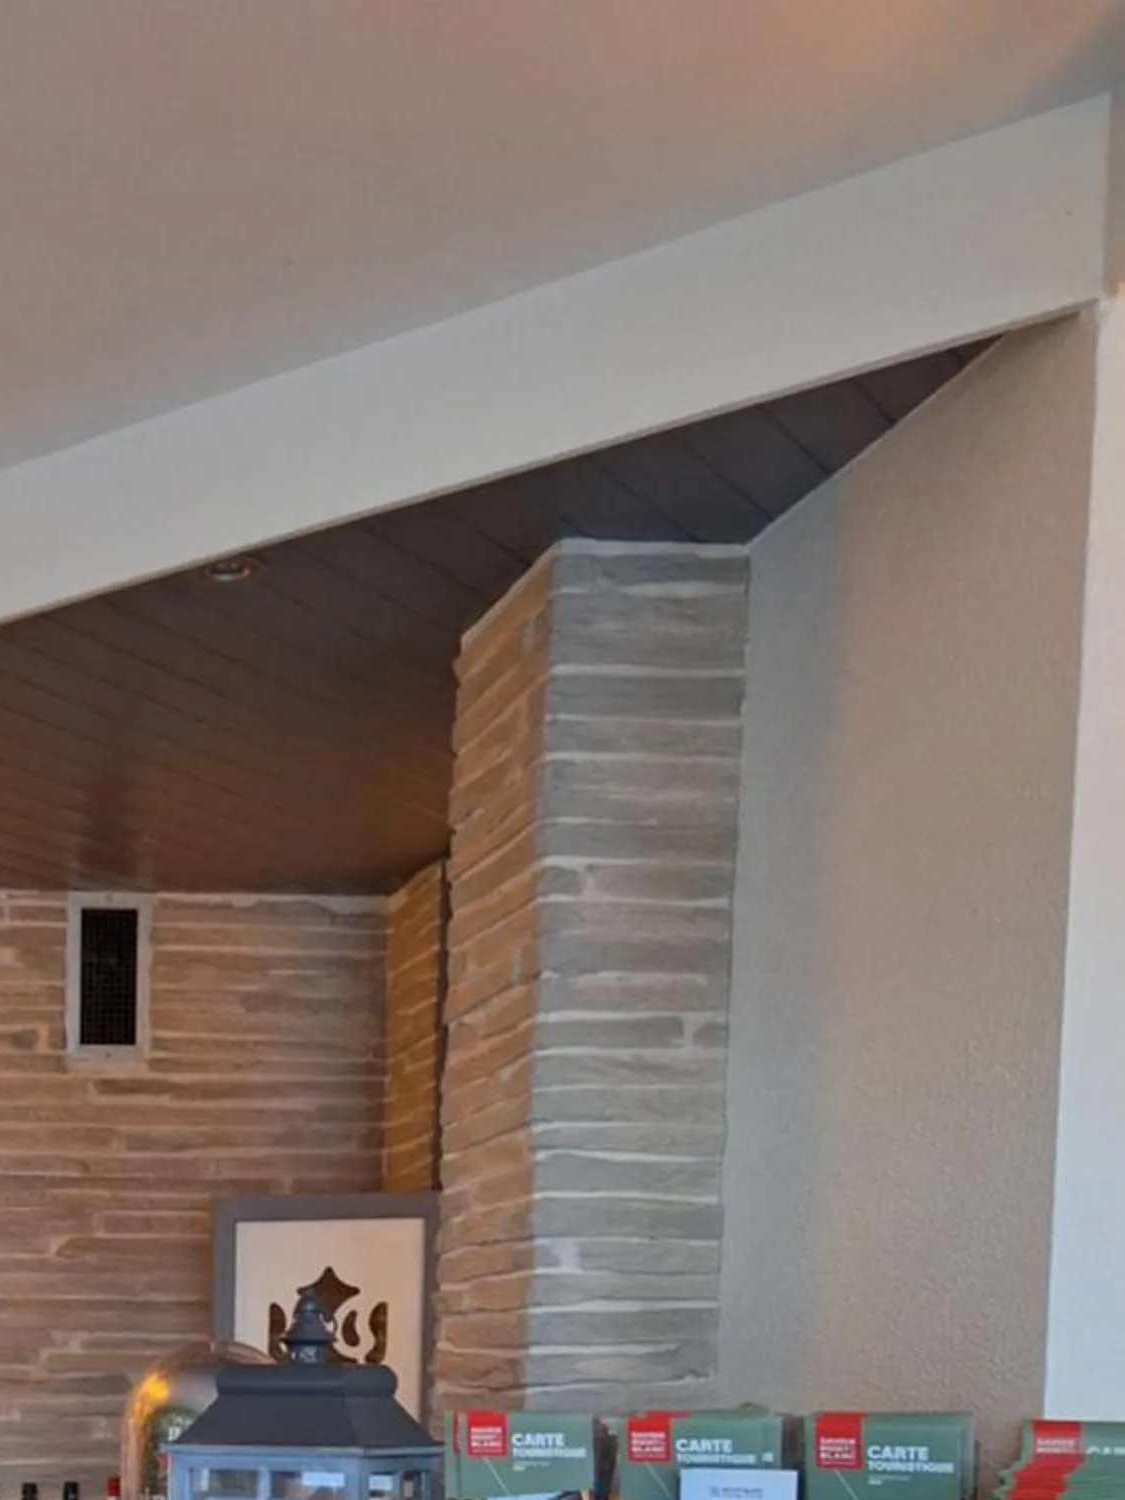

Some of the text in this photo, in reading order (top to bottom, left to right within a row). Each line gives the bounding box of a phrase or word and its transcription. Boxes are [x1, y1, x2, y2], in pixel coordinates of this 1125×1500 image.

[511, 1432, 565, 1448] CARTE
[675, 1437, 733, 1453] CARTE
[866, 1444, 930, 1462] CARTE
